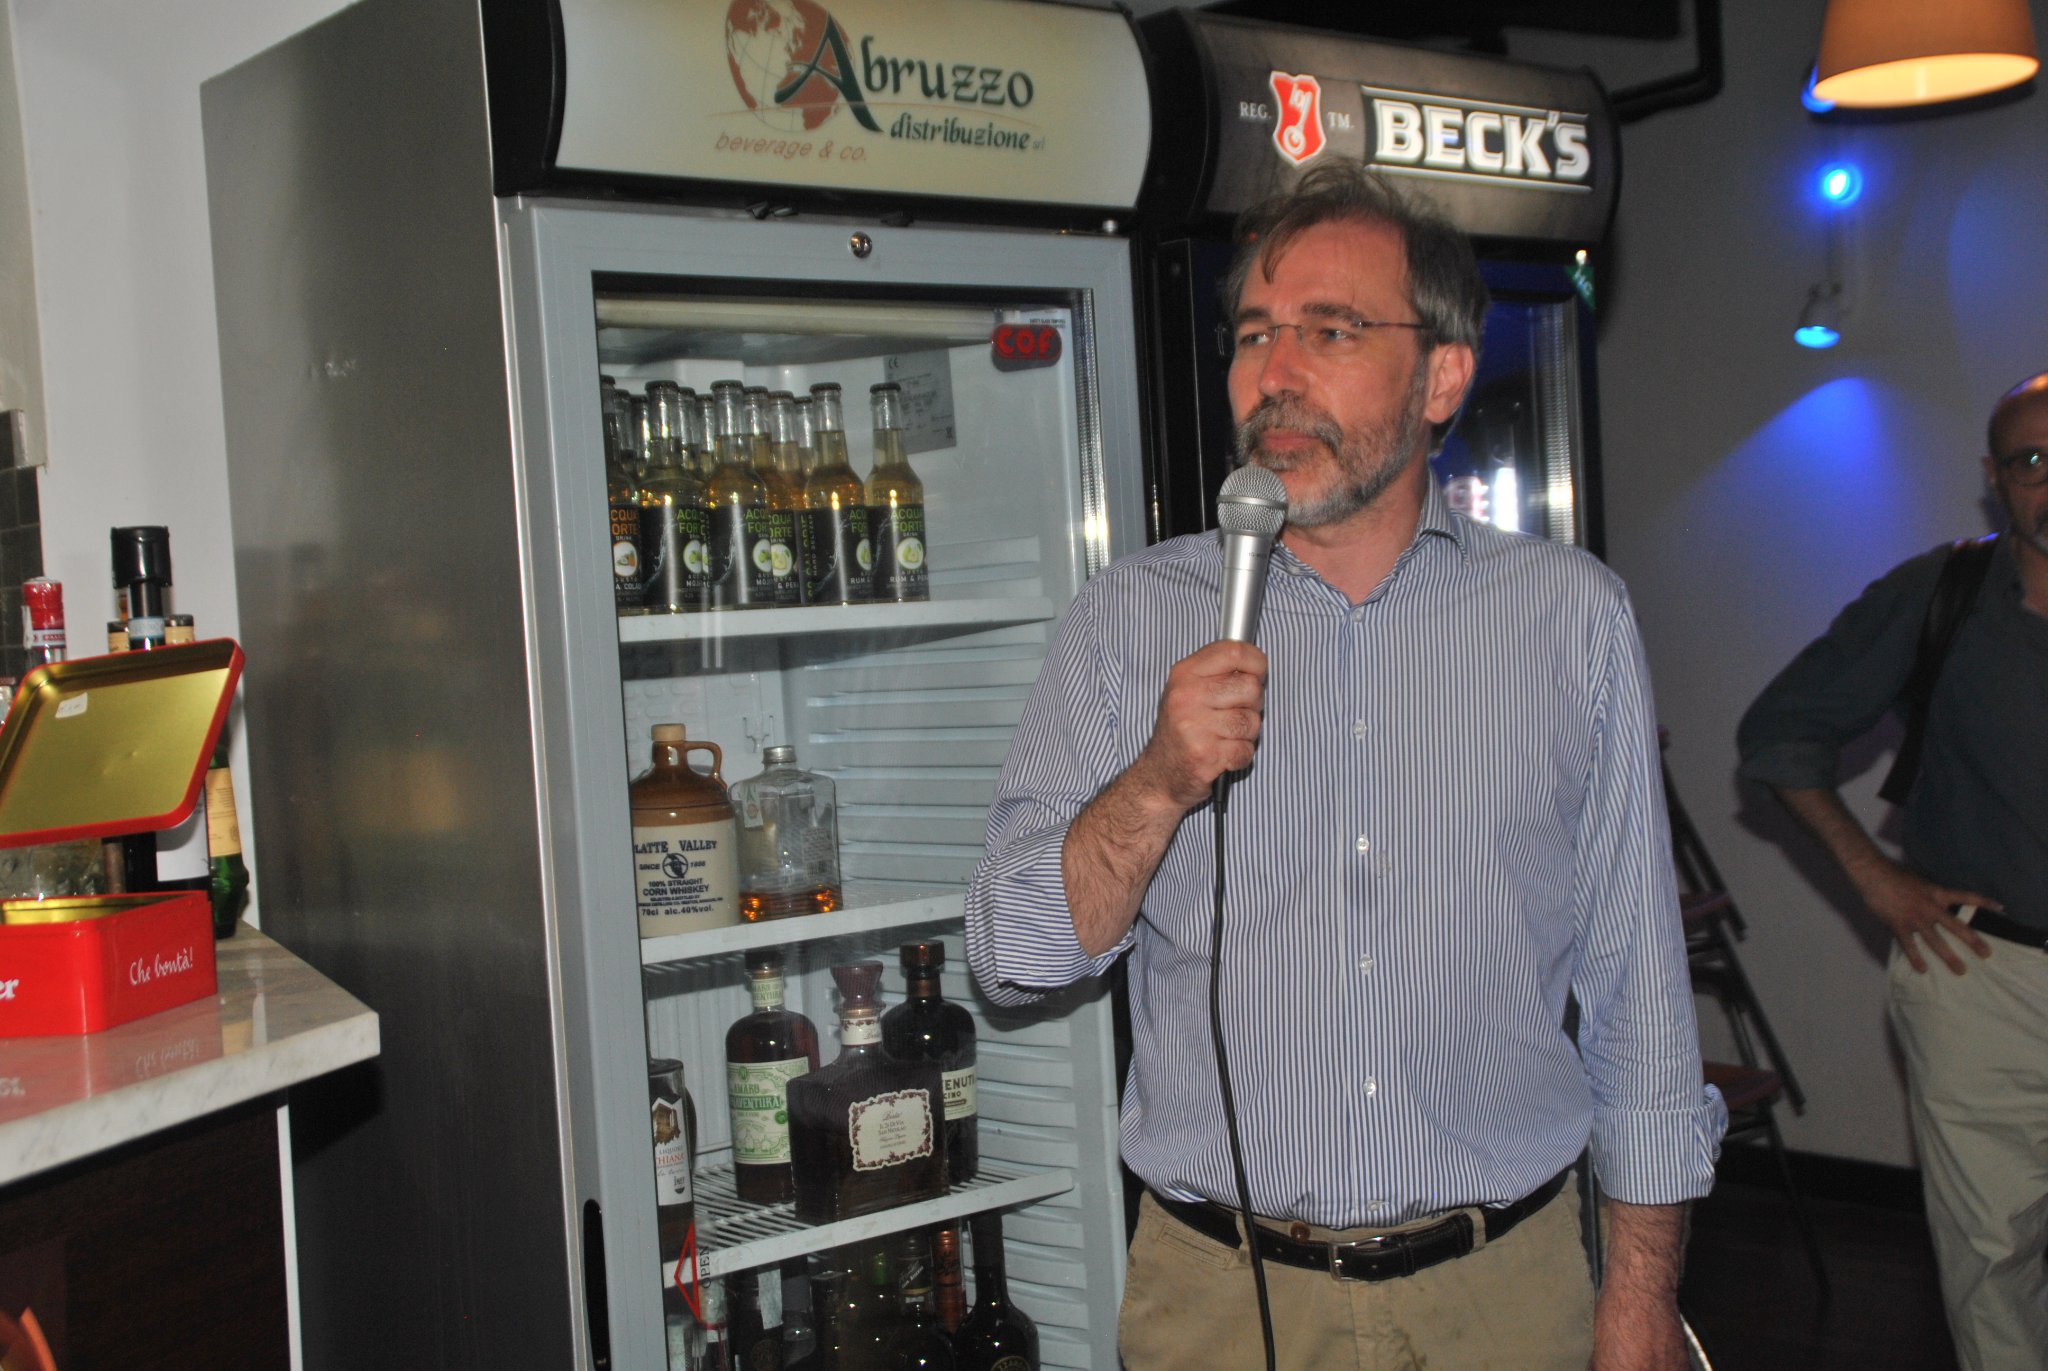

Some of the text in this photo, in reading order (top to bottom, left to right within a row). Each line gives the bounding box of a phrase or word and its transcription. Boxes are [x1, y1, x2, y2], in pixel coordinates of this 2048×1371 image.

[774, 13, 1034, 132] Abruzzo
[890, 112, 1031, 150] distribuzione
[1239, 101, 1355, 129] REG. TM.
[714, 130, 867, 161] beverage & co.
[1373, 97, 1591, 180] BECK'S
[679, 839, 717, 851] VALLEY
[642, 884, 709, 896] CORN WHISKEY
[667, 877, 703, 887] STRAIGHT
[130, 946, 193, 986] Che bontà!
[700, 1246, 712, 1289] OPEN
